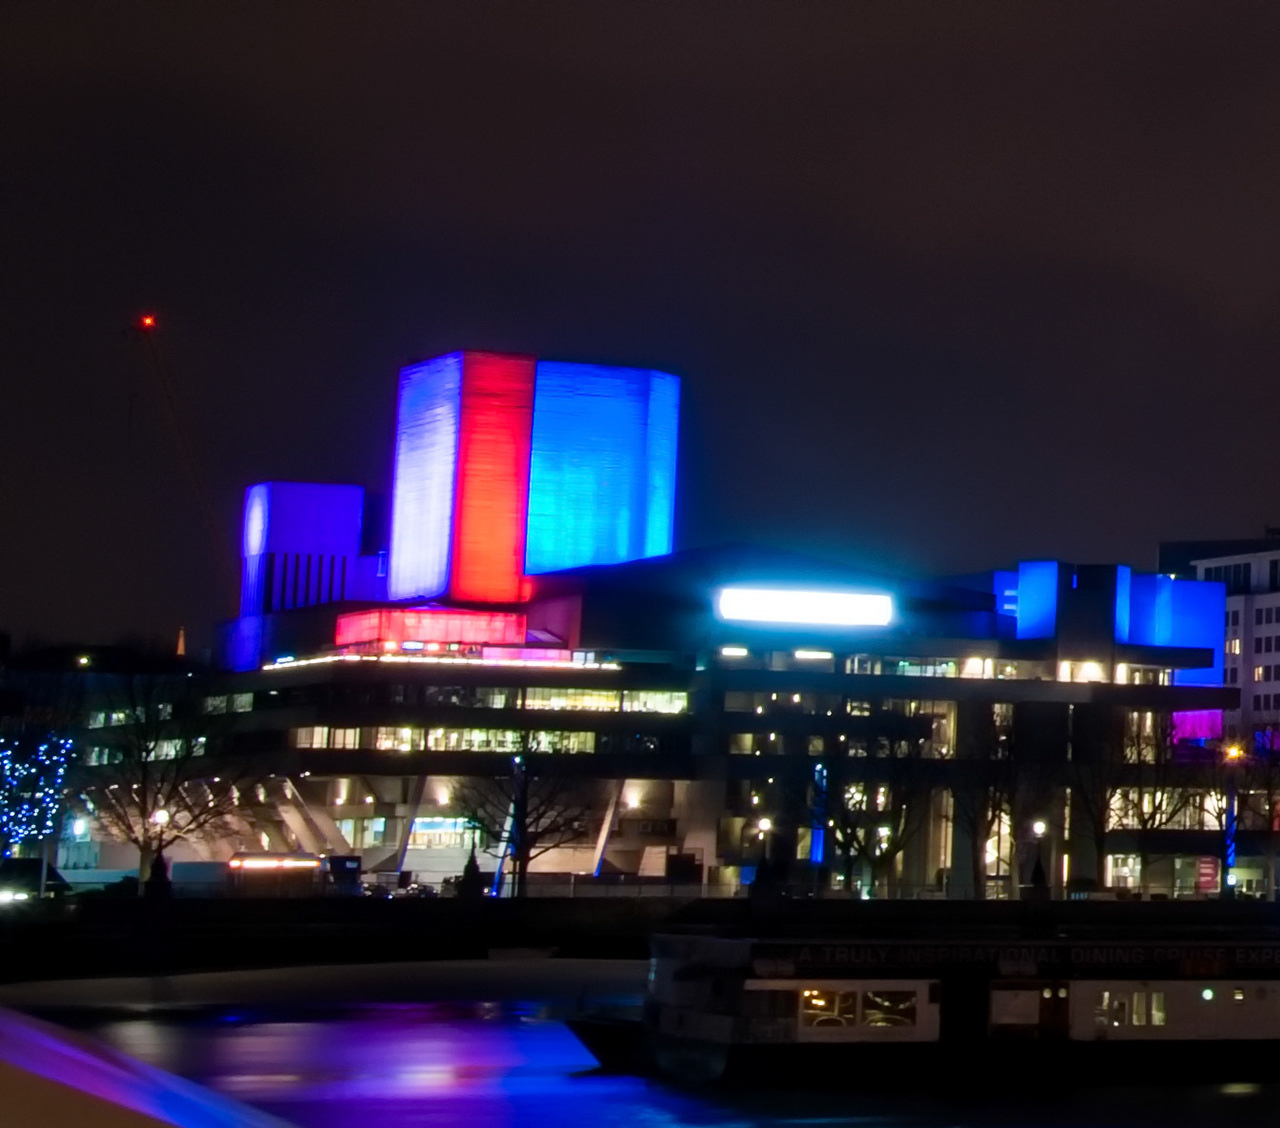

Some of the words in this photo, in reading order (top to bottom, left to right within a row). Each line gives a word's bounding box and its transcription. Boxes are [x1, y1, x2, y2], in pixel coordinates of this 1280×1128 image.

[797, 947, 813, 963] A
[822, 947, 892, 963] TRULY
[900, 947, 1061, 963] INSPIRATIONAL
[1070, 948, 1145, 964] DINING
[1153, 948, 1226, 963] CRUISE
